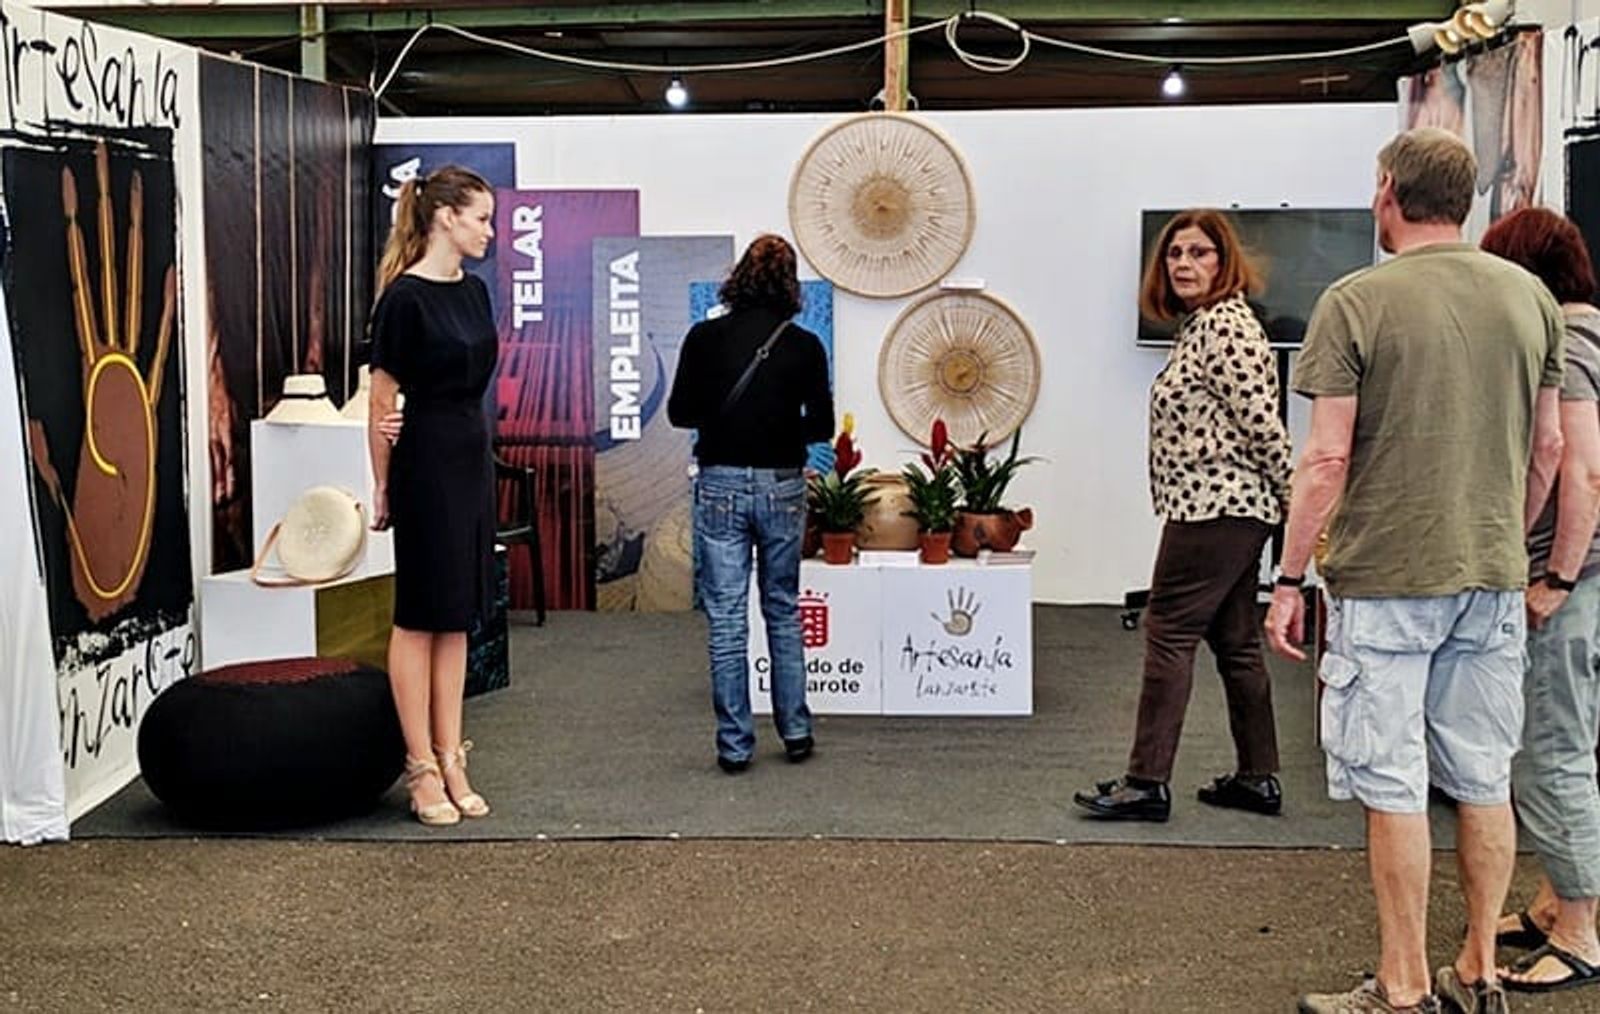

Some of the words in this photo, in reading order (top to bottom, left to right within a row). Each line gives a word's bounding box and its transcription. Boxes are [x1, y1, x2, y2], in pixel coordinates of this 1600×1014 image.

[512, 205, 543, 329] TELAR
[610, 250, 641, 440] EMPLEITA
[838, 658, 864, 674] de
